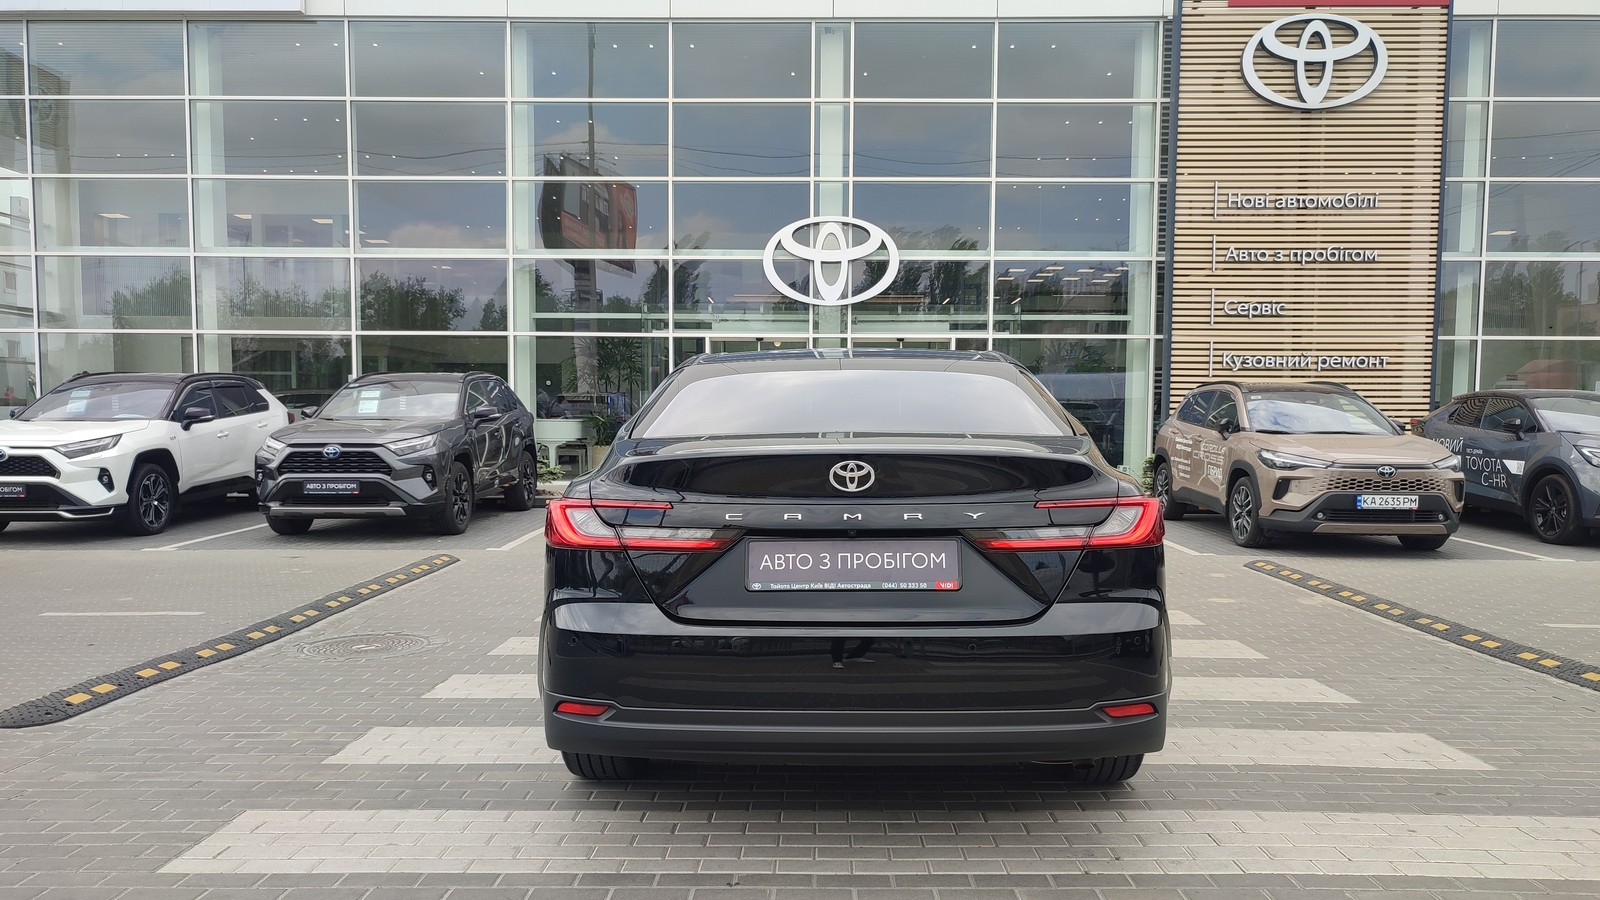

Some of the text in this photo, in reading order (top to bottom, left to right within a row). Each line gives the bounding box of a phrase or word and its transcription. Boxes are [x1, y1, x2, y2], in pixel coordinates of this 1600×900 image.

[1227, 192, 1379, 208] Нові автомобілі
[1225, 245, 1378, 265] Авто з пробігом
[1223, 299, 1287, 319] Сервіс
[1222, 352, 1389, 371] Кузовний ремонт
[1465, 456, 1503, 473] TOYOTA
[1481, 472, 1508, 488] C-HR
[1378, 497, 1401, 506] 2635
[725, 511, 987, 520] CAMRY
[759, 552, 946, 570] АВТО З ПРОБІГОМ
